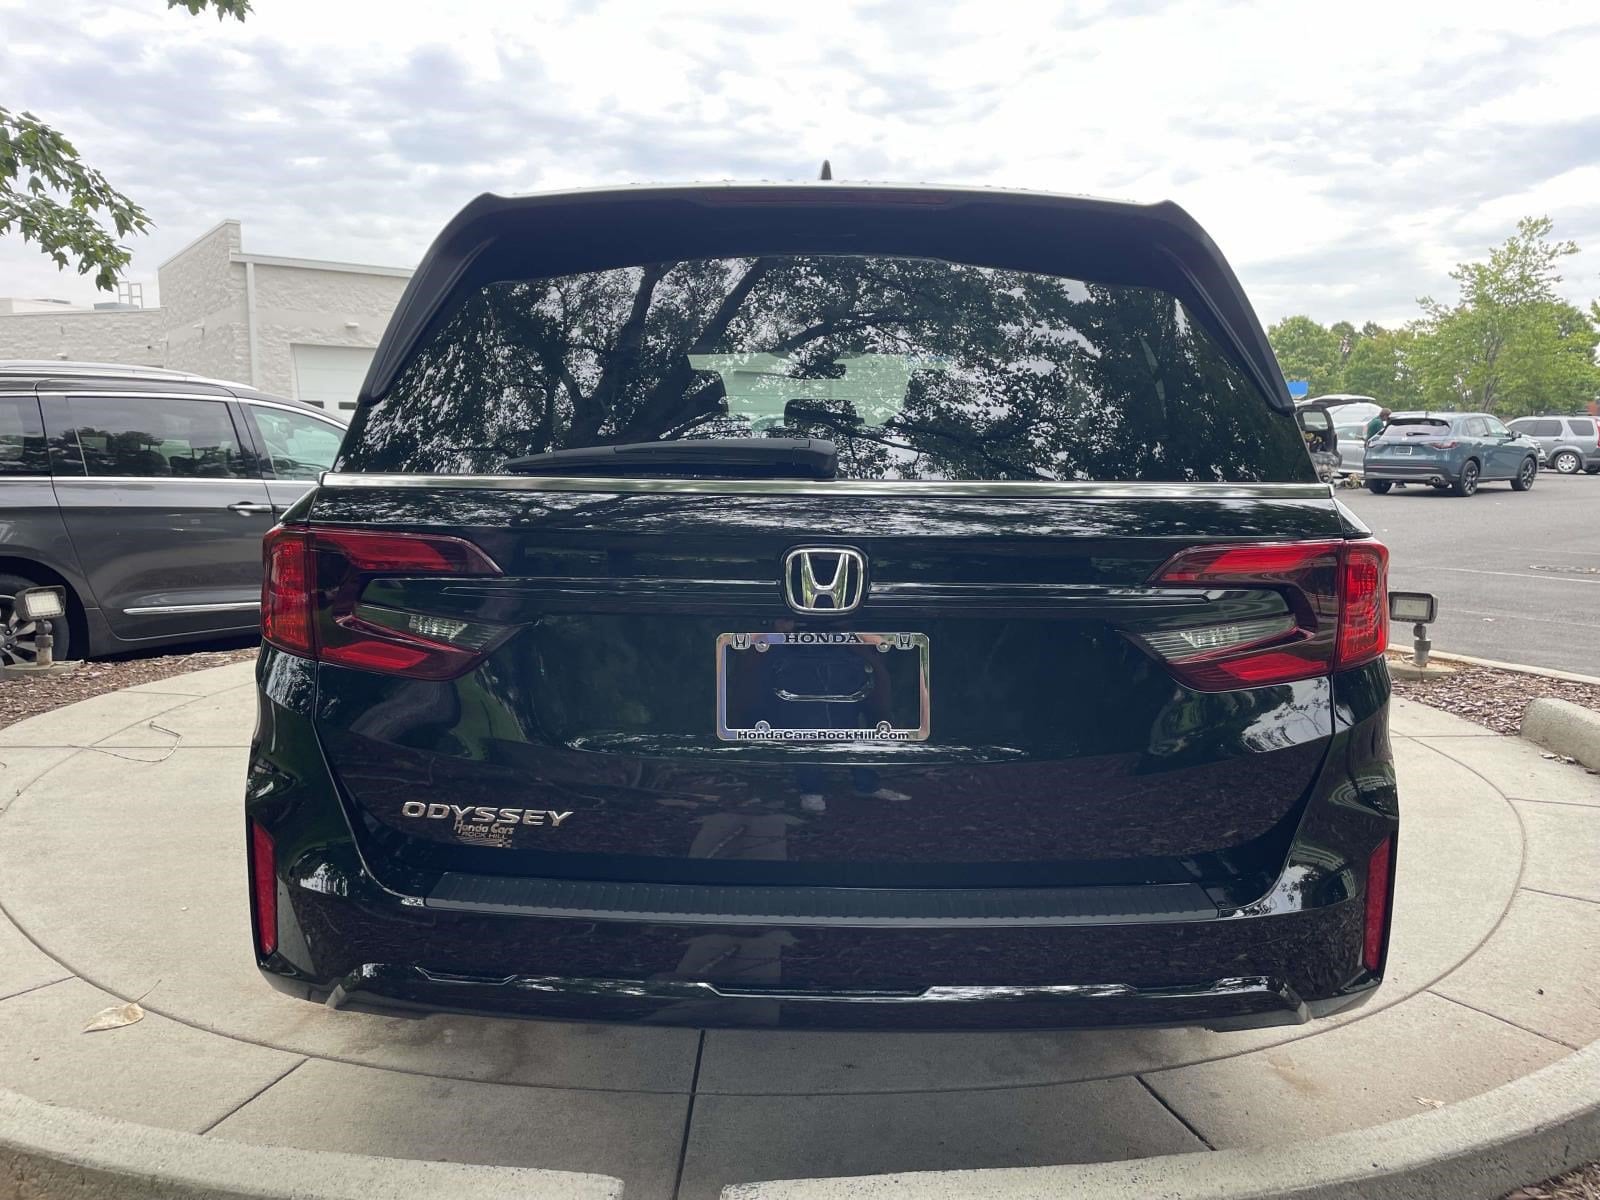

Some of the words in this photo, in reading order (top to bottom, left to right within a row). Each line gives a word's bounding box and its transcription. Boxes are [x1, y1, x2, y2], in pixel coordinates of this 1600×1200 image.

[784, 632, 862, 644] HONDA
[736, 730, 910, 741] HondaCarsRockHill.com
[402, 801, 574, 828] ODYSSEY
[453, 819, 489, 834] Honda
[490, 822, 515, 835] Cars
